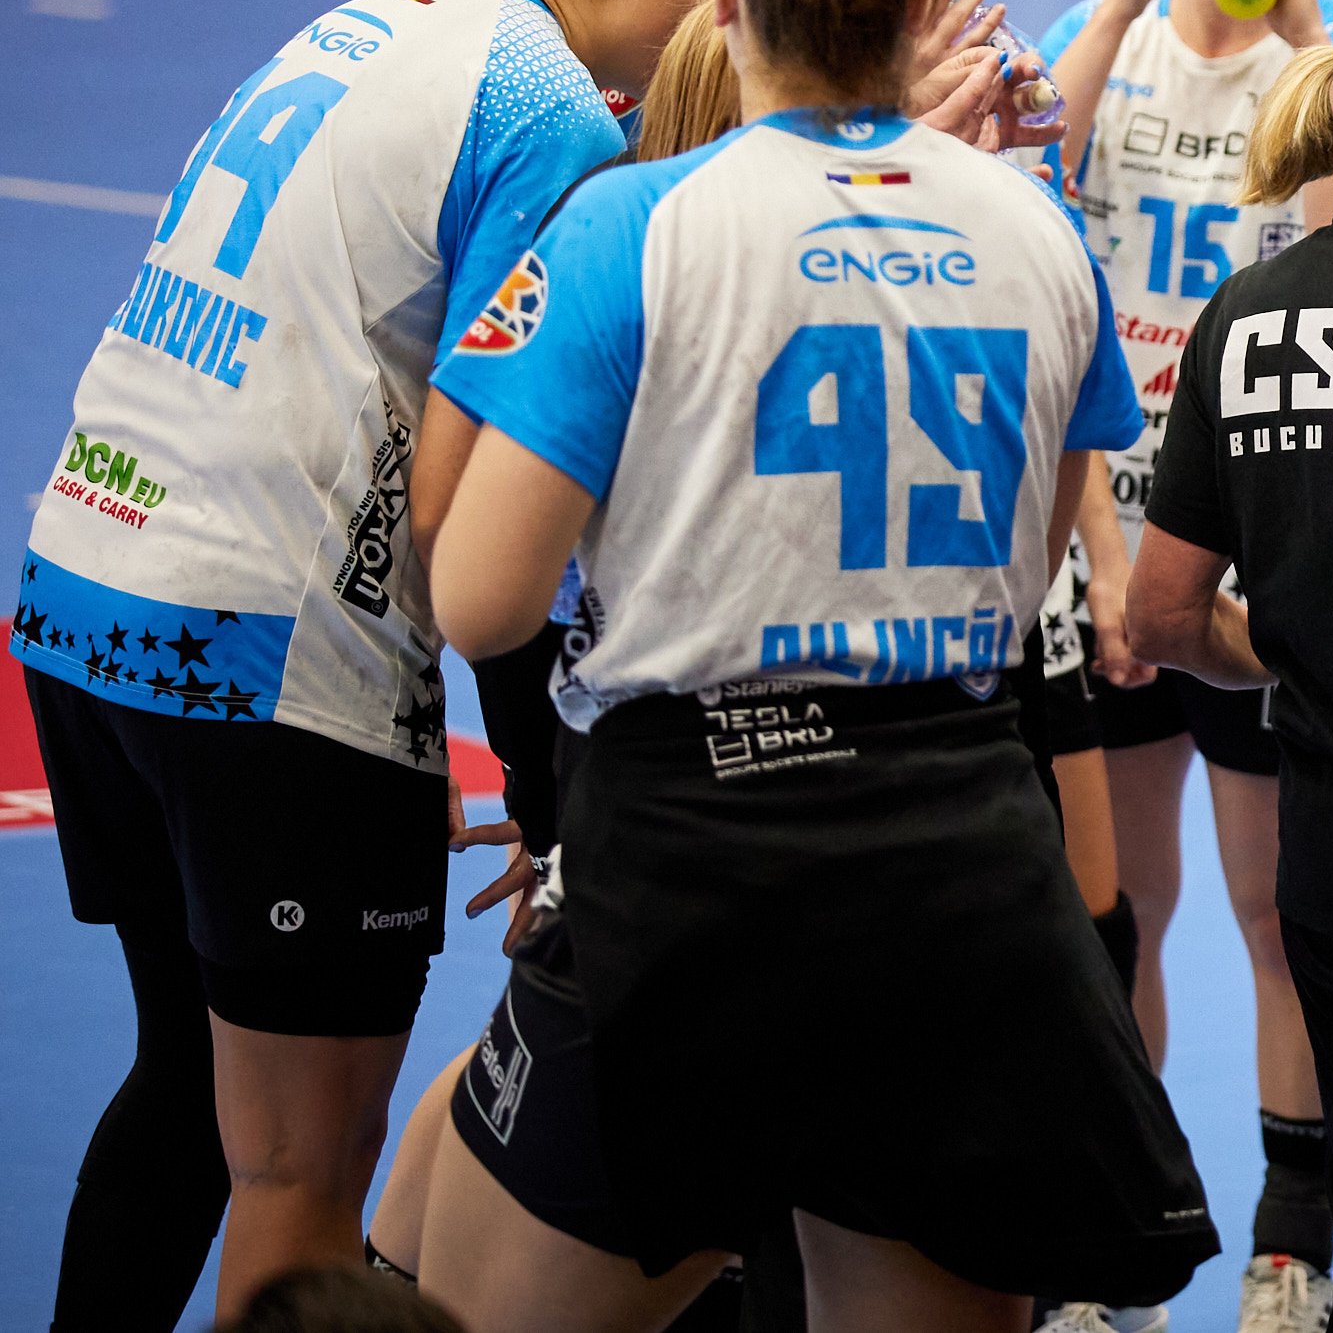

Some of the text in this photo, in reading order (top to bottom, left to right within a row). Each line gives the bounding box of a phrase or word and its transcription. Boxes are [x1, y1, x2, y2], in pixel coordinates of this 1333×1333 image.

[1139, 196, 1240, 300] 15
[65, 432, 166, 509] DCN EU
[755, 324, 1028, 570] 49
[53, 476, 149, 529] CASH & CARRY
[705, 702, 825, 732] TESLA
[362, 906, 429, 931] Kempa
